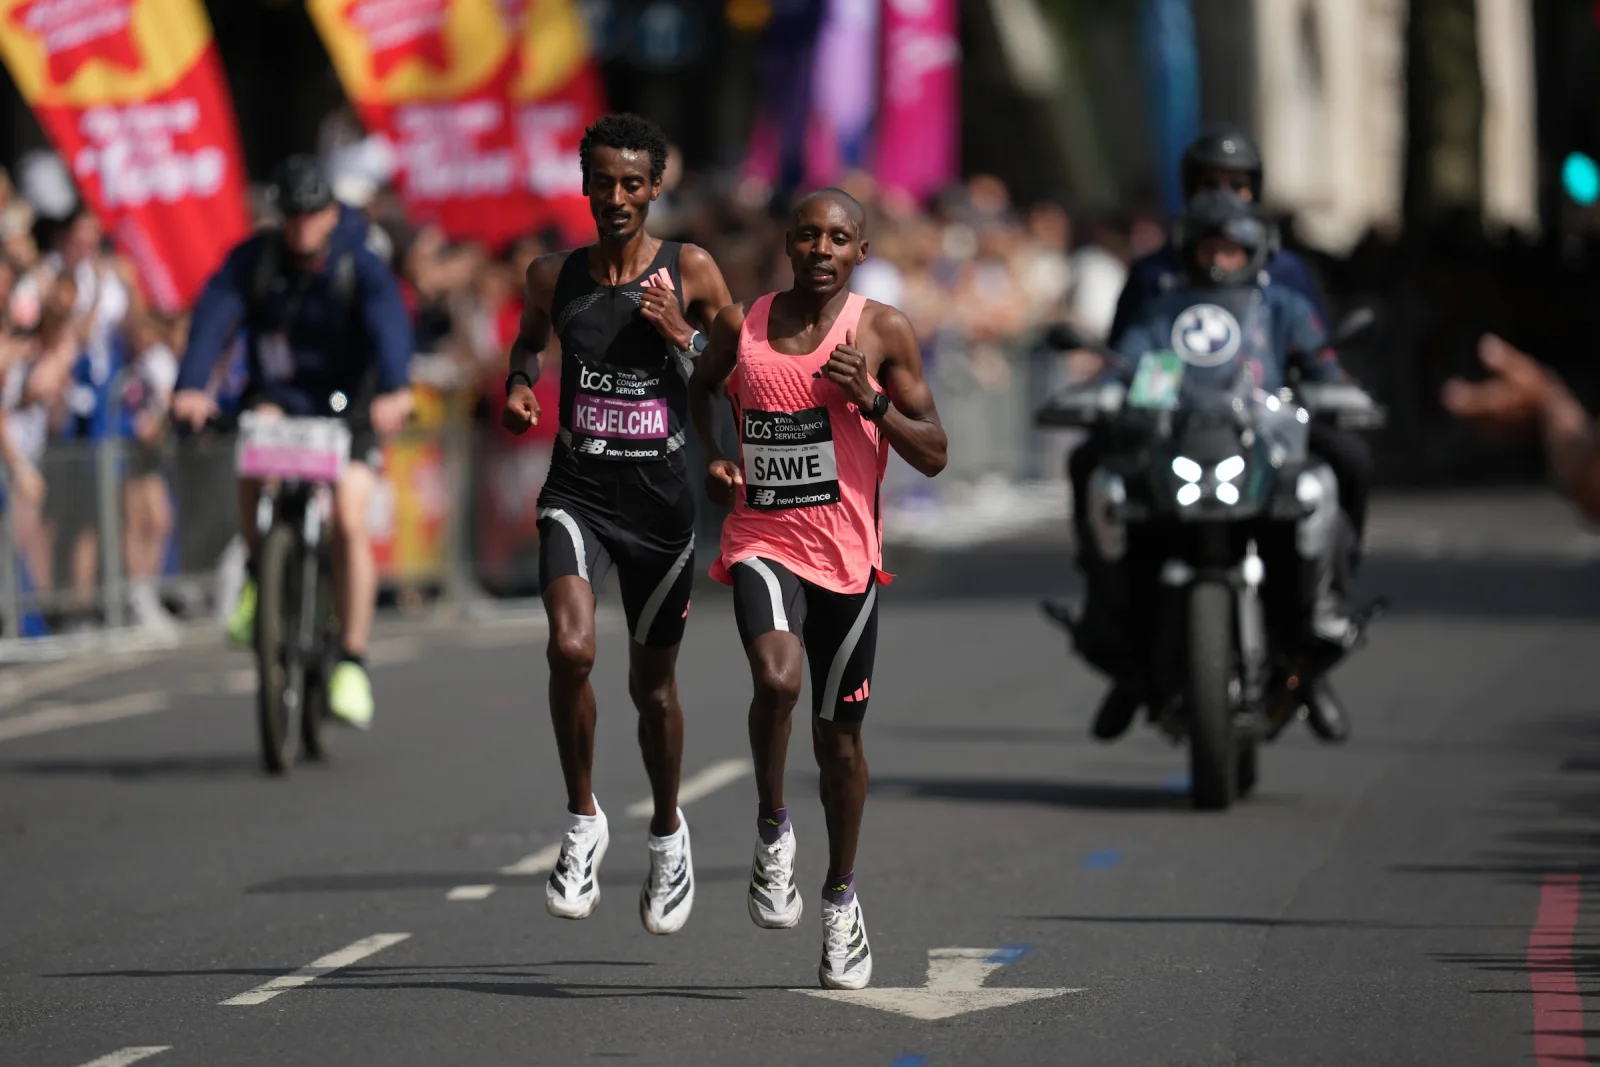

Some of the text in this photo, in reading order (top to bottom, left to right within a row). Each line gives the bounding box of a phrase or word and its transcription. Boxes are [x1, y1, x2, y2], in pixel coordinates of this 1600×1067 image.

[580, 366, 613, 392] tcs
[616, 372, 638, 381] TATA
[615, 387, 646, 396] SERVICES
[576, 405, 665, 435] KEJELCHA
[745, 415, 773, 440] tcs
[774, 432, 807, 440] SERVICES
[606, 448, 659, 457] new balance
[754, 454, 822, 481] SAWE
[776, 493, 831, 505] new balance
